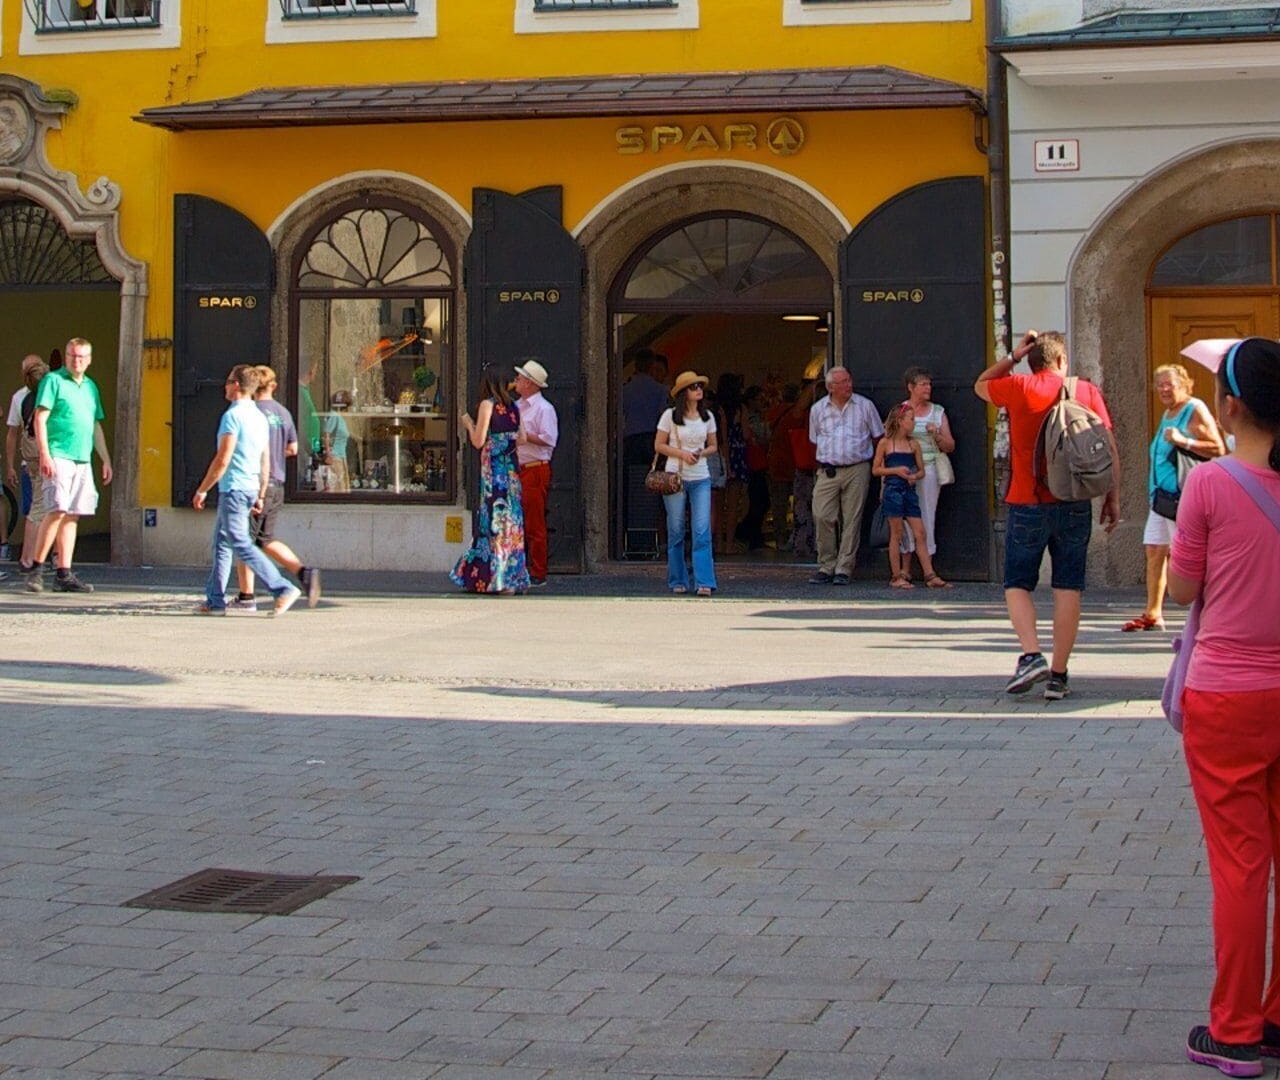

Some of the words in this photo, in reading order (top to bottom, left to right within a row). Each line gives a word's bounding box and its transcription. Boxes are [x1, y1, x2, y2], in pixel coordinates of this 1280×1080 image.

[616, 124, 758, 154] SPAR
[1047, 144, 1065, 160] 11
[199, 296, 244, 308] SPAR
[499, 291, 545, 302] SPAR
[862, 291, 909, 302] SPAR
